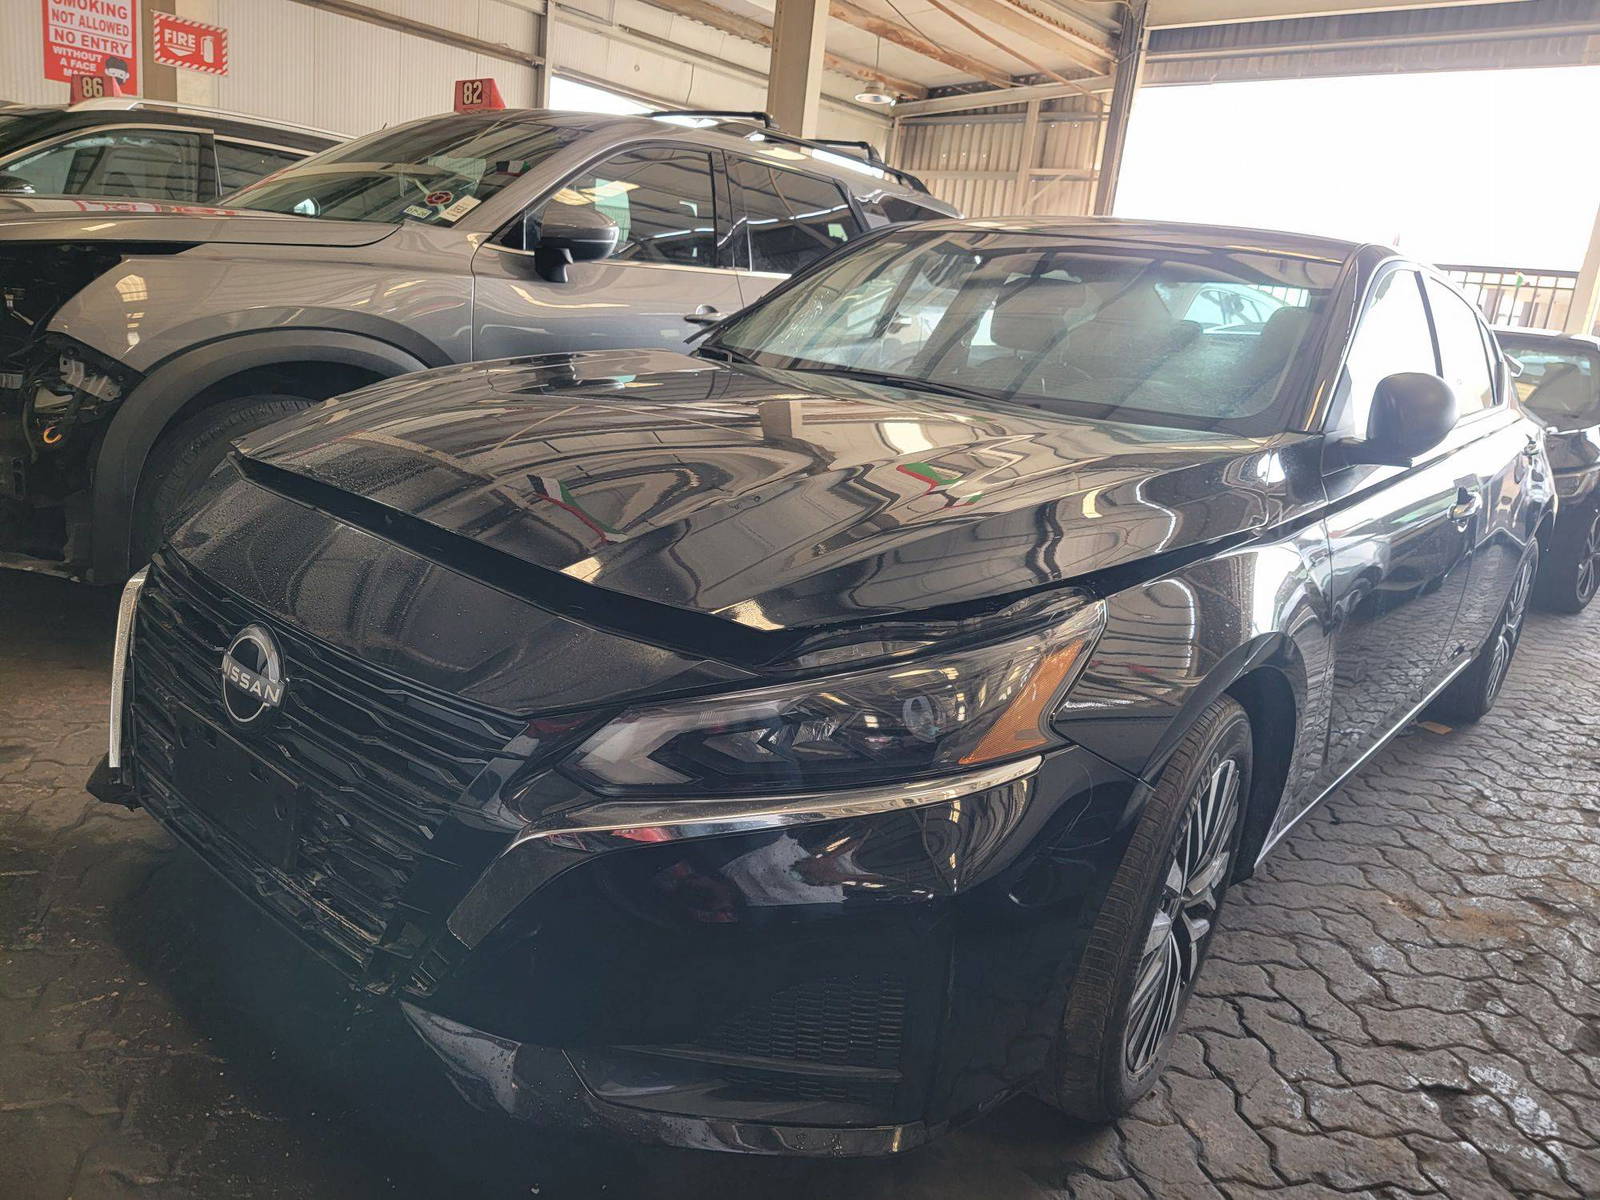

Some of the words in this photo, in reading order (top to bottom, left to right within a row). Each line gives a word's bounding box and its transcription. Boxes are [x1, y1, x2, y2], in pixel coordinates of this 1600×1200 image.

[52, 8, 75, 25] NOT
[79, 15, 129, 37] ALLOWED
[54, 28, 75, 43] NO
[81, 35, 128, 55] ENTRY
[164, 28, 196, 48] FIRE
[52, 46, 102, 63] WITHOUT
[60, 57, 67, 66] A
[70, 59, 97, 71] FACE
[82, 77, 103, 97] 86
[463, 81, 482, 104] 82
[222, 654, 280, 703] NISSAN
